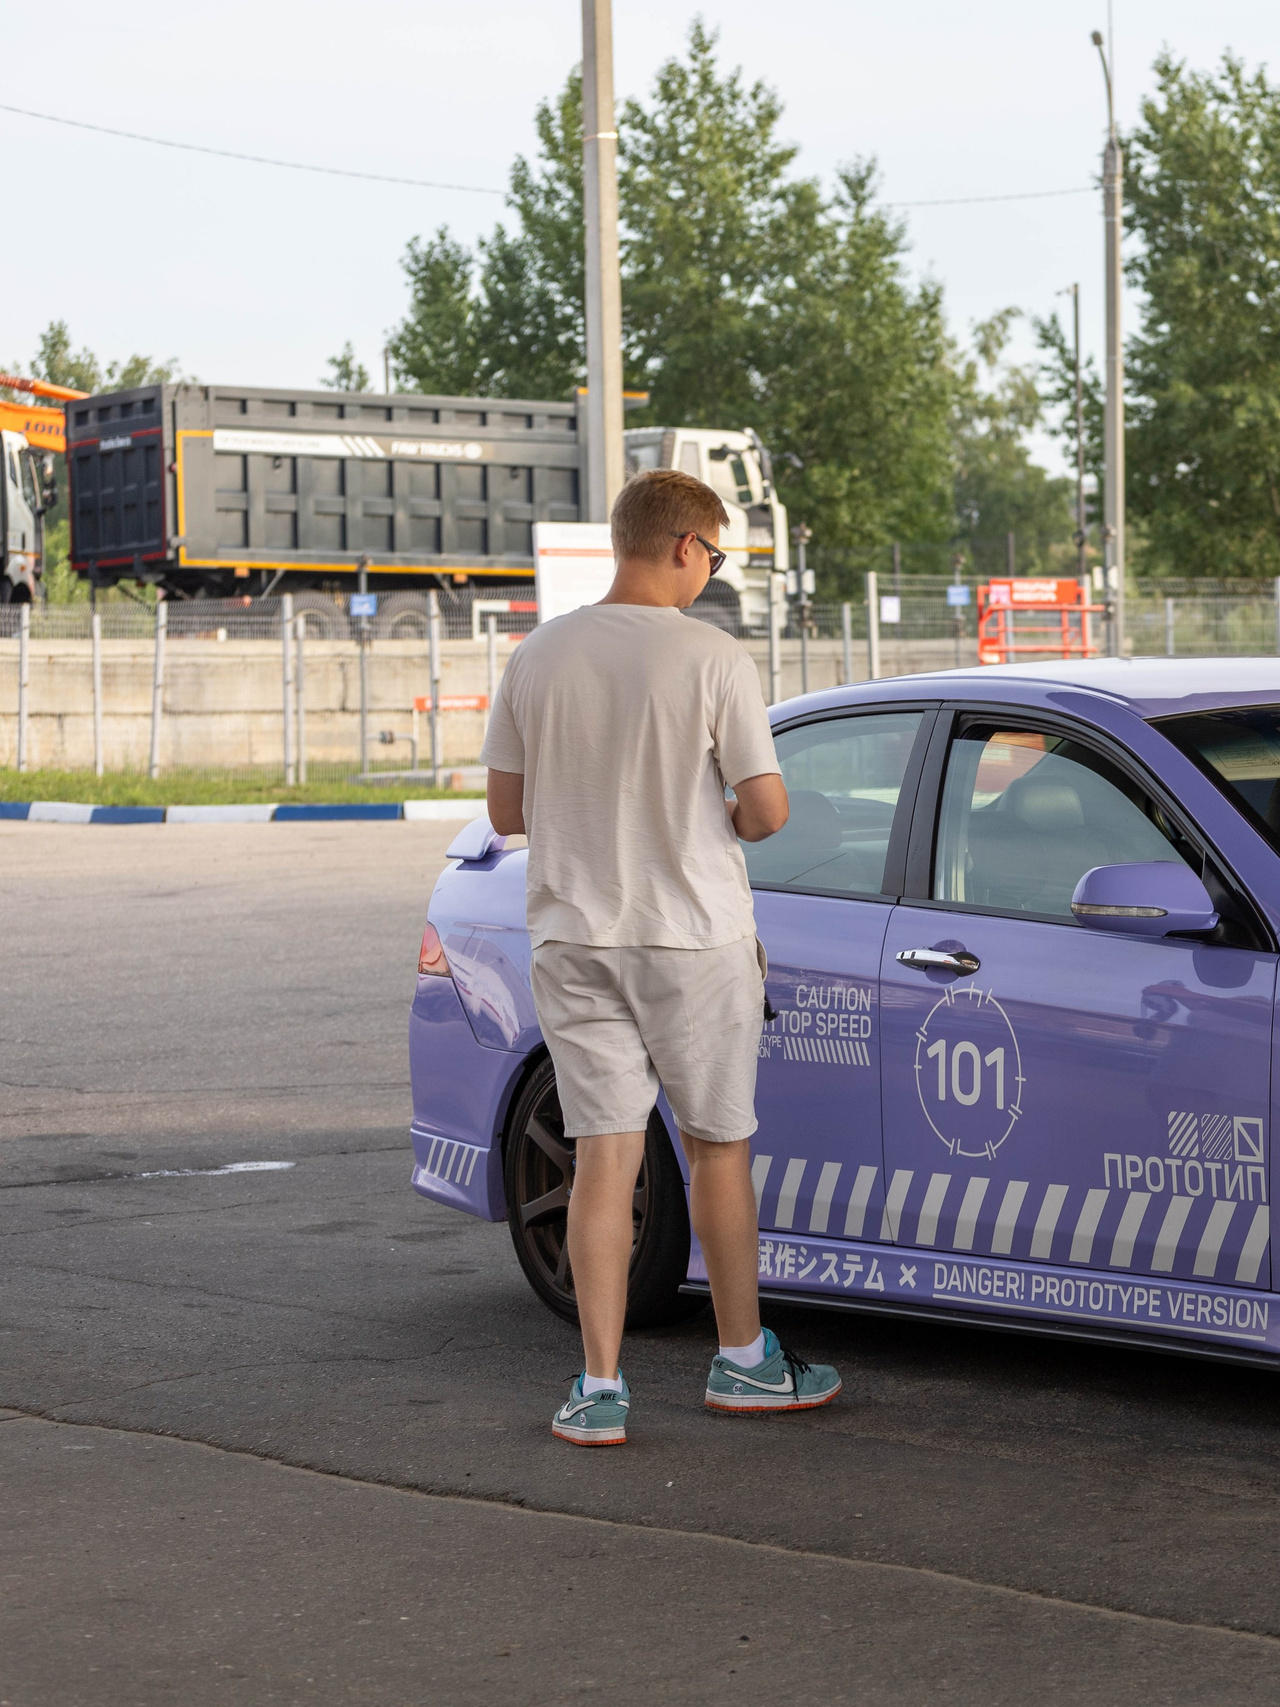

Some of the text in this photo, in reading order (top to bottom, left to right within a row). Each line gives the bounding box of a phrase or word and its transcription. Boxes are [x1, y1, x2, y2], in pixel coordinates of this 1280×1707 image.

[796, 984, 872, 1012] CAUTION
[779, 1010, 812, 1034] TOP
[815, 1012, 872, 1039] SPEED
[926, 1039, 1005, 1110] 101
[1103, 1153, 1267, 1203] ПРОТОТИП
[934, 1263, 1025, 1300] DANGER!
[1031, 1274, 1162, 1318] PROTOTYPE
[1166, 1290, 1269, 1331] VERSION
[600, 1393, 617, 1401] NIKE
